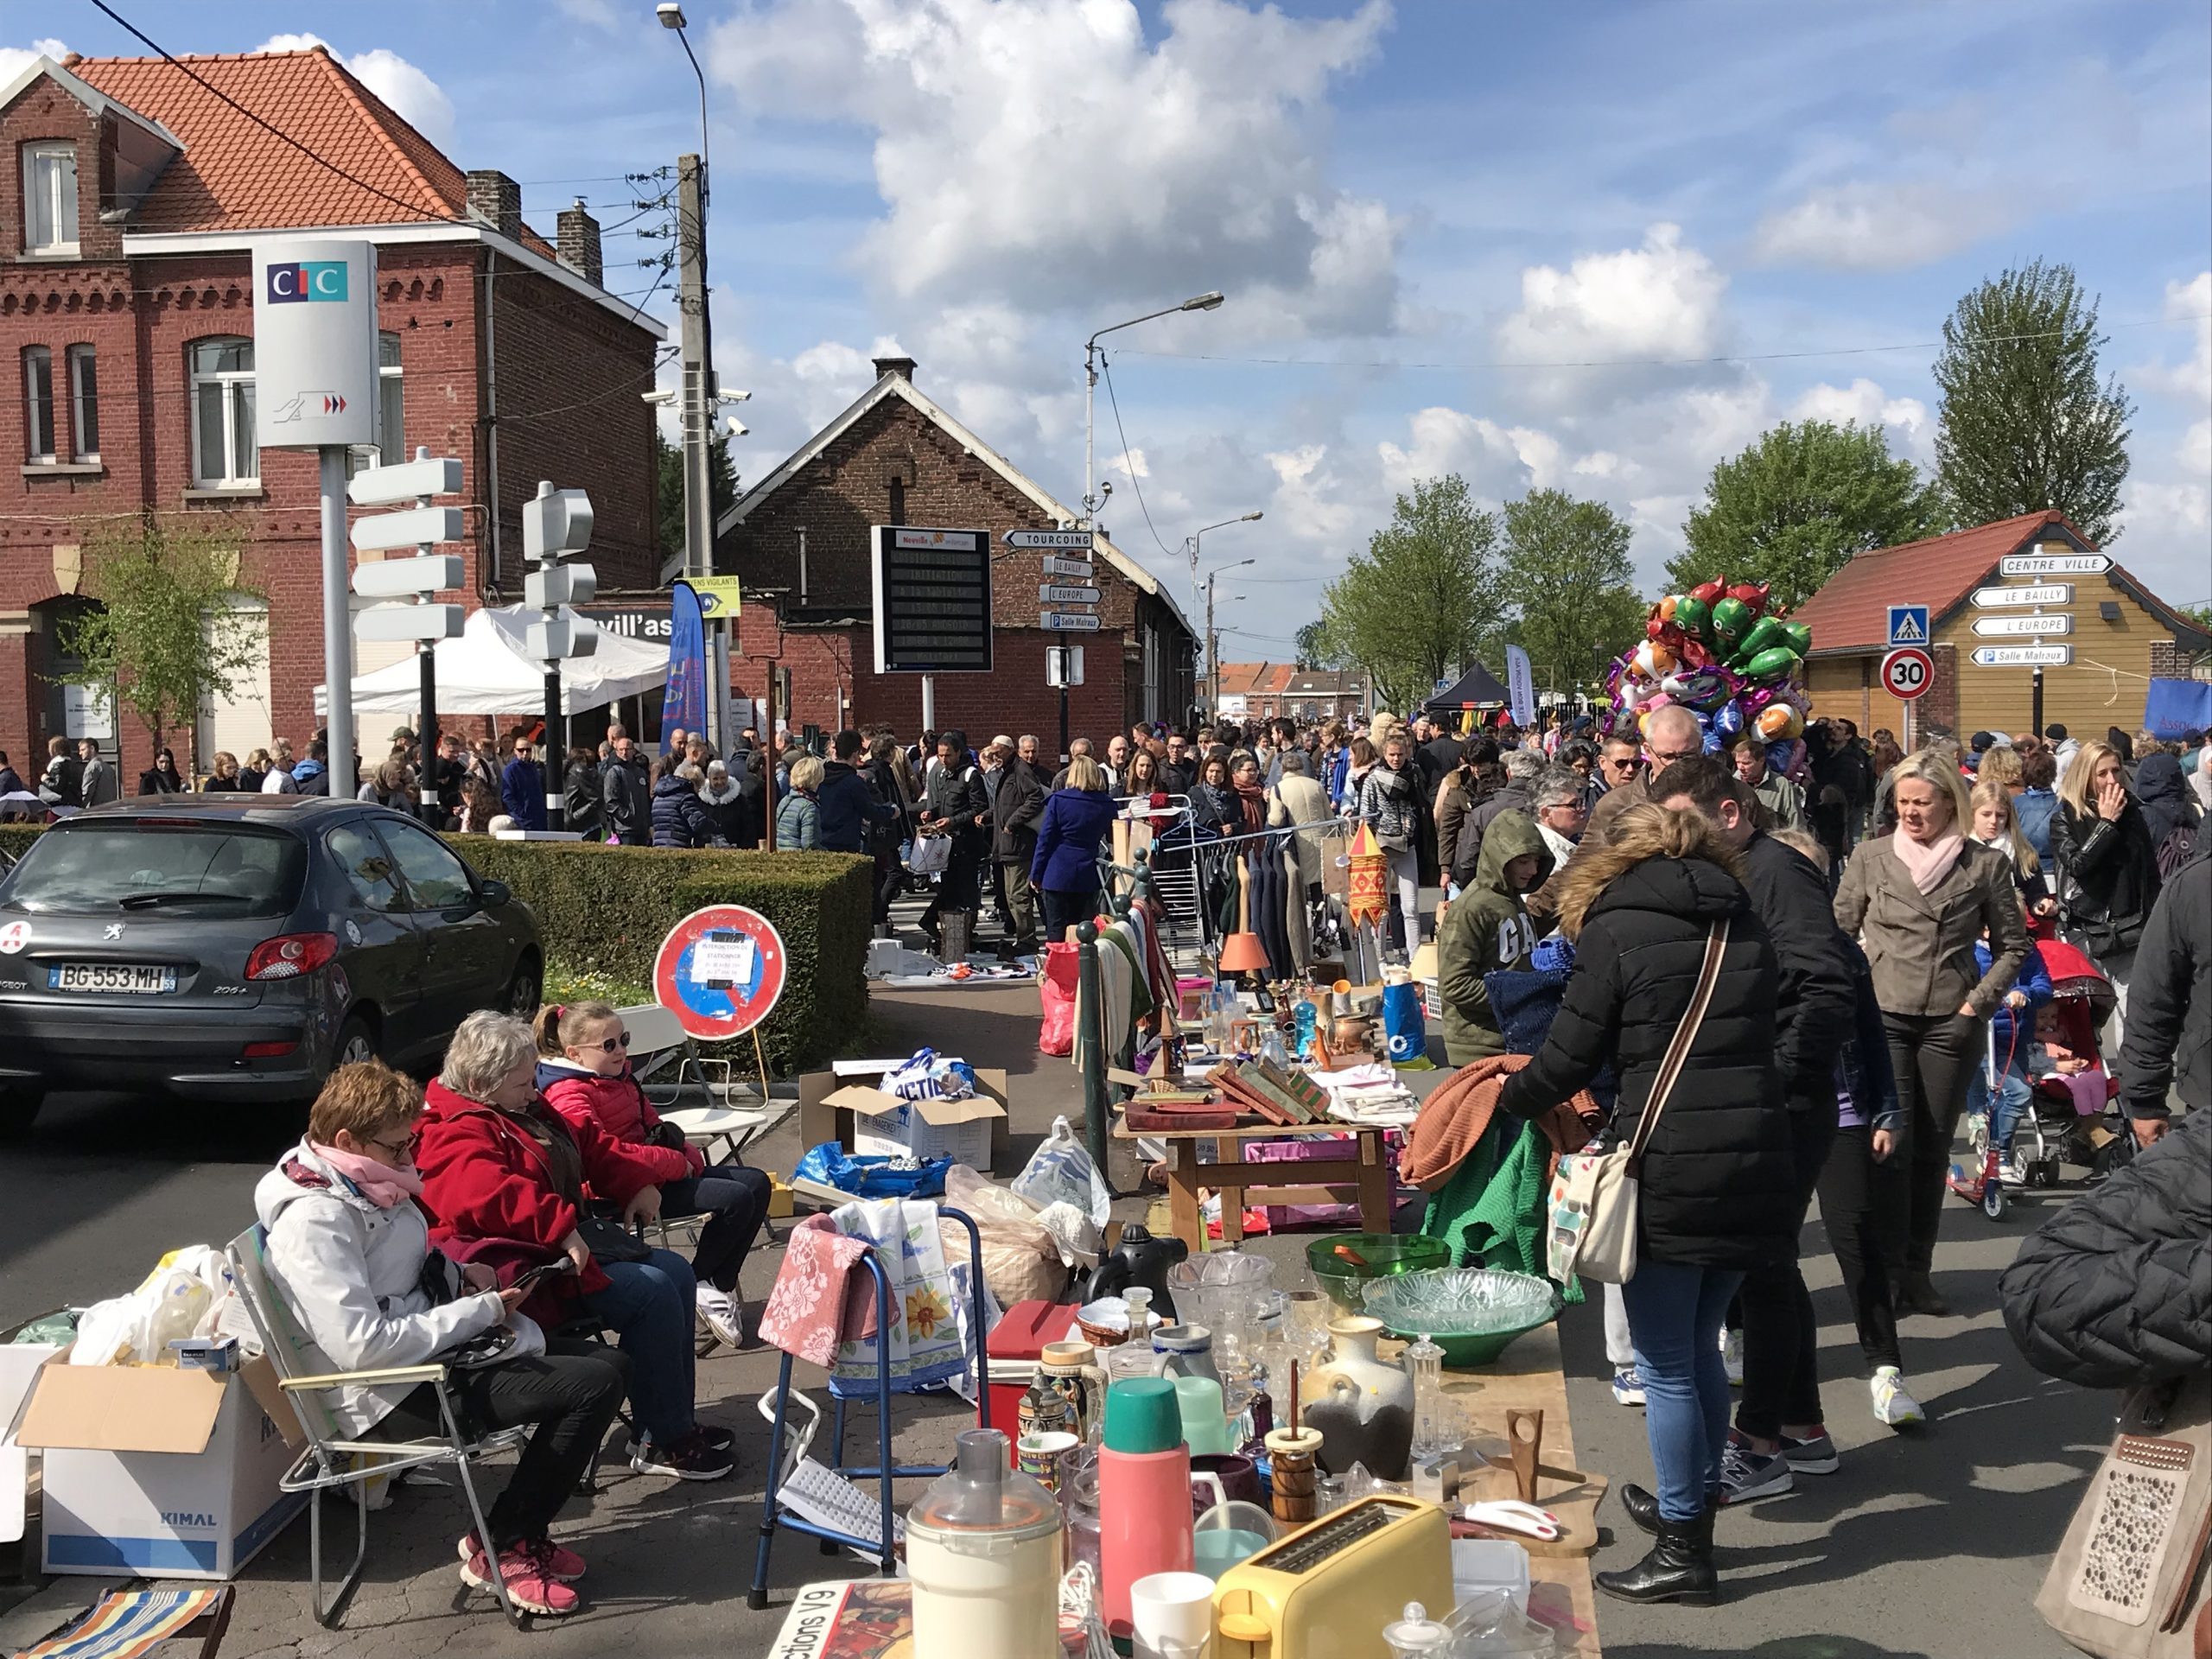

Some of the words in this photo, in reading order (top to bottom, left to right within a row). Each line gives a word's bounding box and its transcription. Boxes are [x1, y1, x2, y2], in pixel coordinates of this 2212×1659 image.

[272, 269, 339, 296] CIC
[1027, 535, 1089, 544] TOURCOING
[1055, 561, 1063, 570] LE
[2007, 560, 2056, 571] CENTRE
[2065, 558, 2099, 569] VILLE
[706, 577, 737, 586] VIGILANTS
[2005, 592, 2017, 601] LE
[2024, 589, 2063, 601] BAILLY
[1062, 617, 1074, 626] Salle
[1076, 617, 1096, 627] Malraux
[2018, 620, 2063, 631] EUROPE
[1999, 652, 2021, 661] Salle
[2024, 651, 2063, 661] Malraux
[1892, 663, 1924, 685] 30
[0, 981, 29, 989] GEOT
[163, 978, 176, 989] 59
[213, 986, 248, 995] 206+
[1724, 1461, 1752, 1483] N
[160, 1512, 218, 1527] KIMAL
